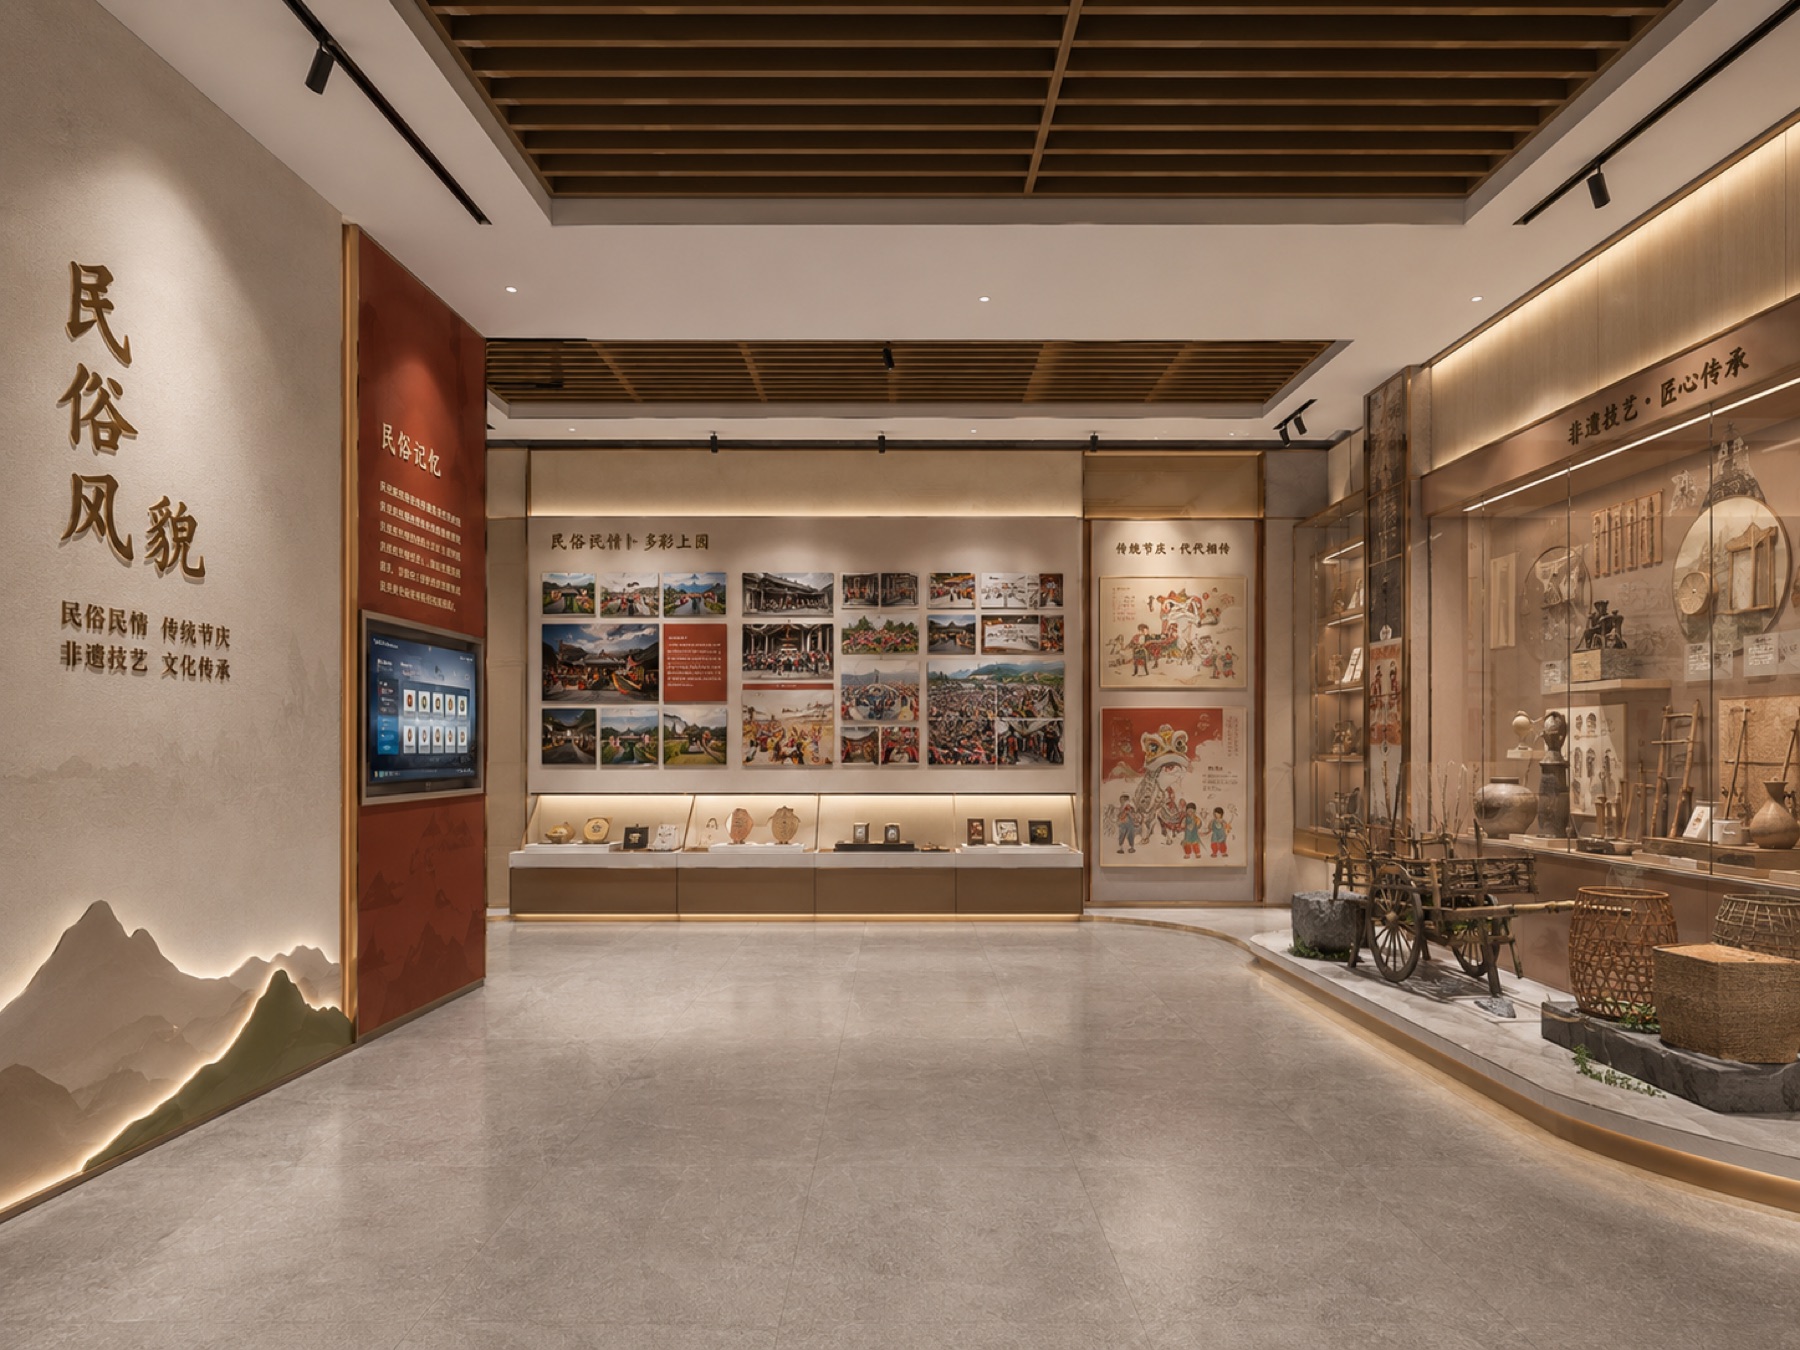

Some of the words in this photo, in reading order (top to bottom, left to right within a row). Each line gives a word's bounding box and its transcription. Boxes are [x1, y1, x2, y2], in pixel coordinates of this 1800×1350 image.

[381, 422, 442, 478] 民俗记忆
[60, 600, 149, 637] 民俗民情
[161, 616, 231, 650] 传统节庆
[60, 640, 149, 676] 非遗技艺
[161, 652, 231, 684] 文化传承
